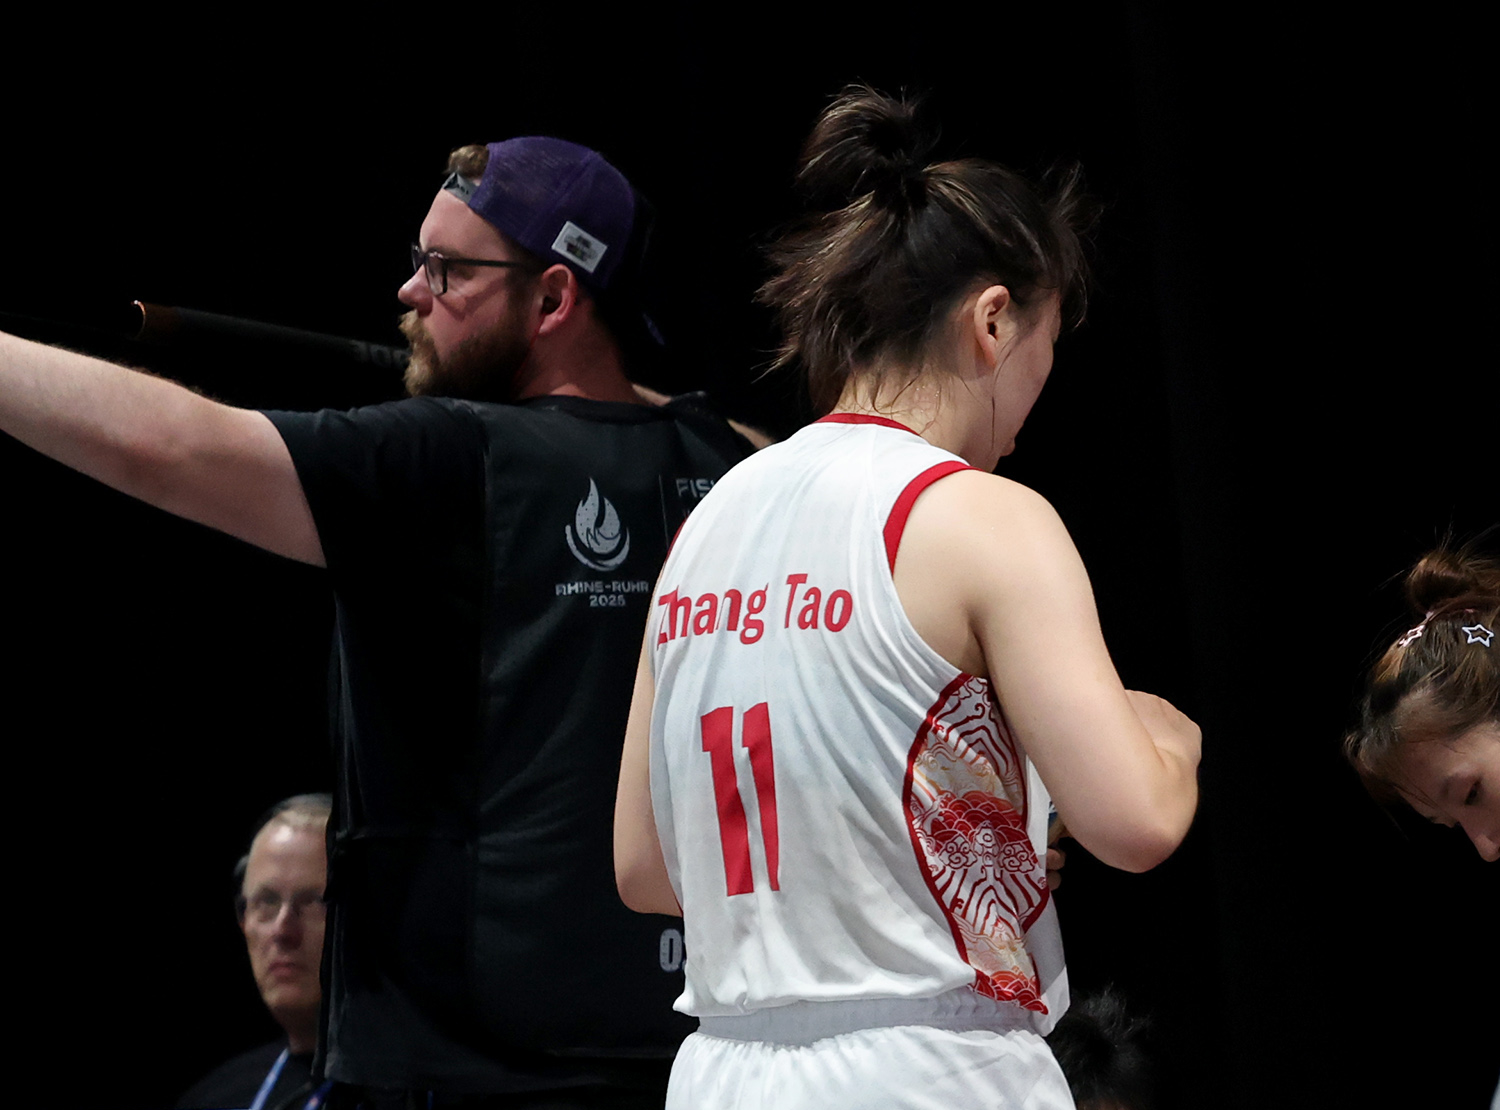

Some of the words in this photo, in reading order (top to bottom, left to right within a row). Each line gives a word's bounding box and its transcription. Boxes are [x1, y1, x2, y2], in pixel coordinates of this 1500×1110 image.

[675, 478, 716, 498] FIS
[555, 580, 649, 596] RHINE-RUHR
[589, 595, 627, 607] 2025
[657, 582, 770, 650] Zhang
[784, 573, 854, 633] Tao
[700, 702, 781, 897] 11
